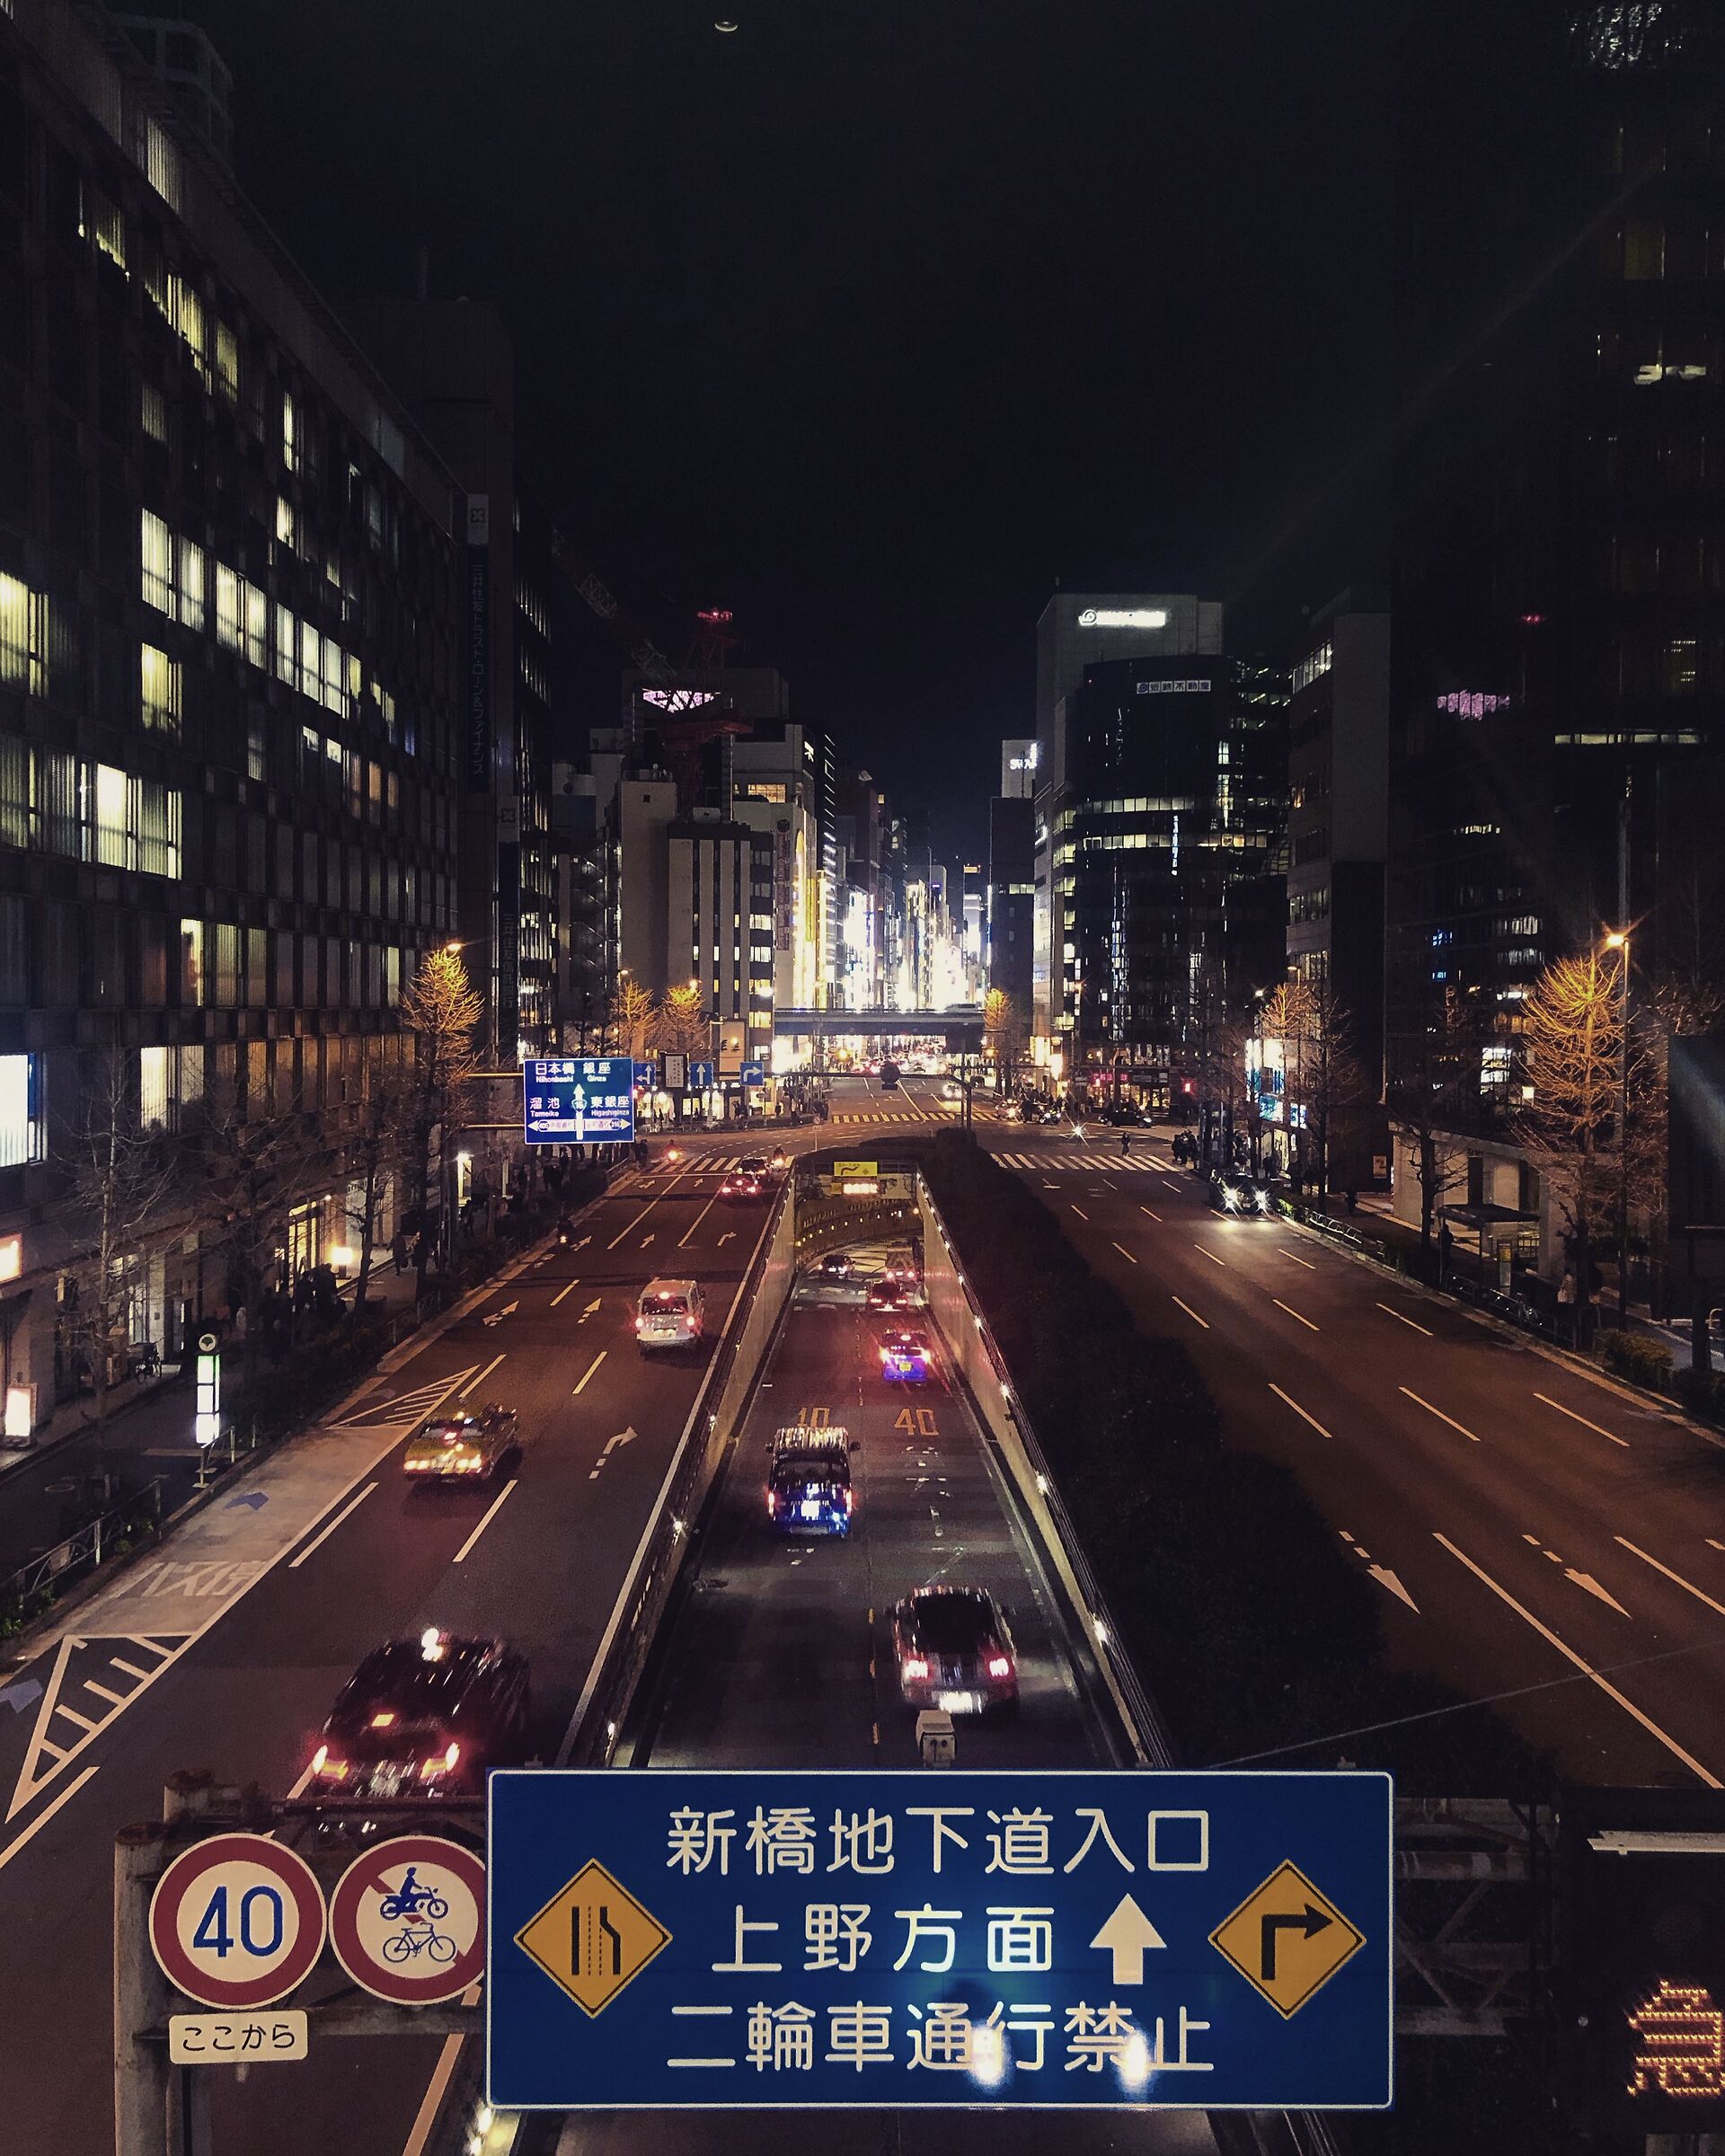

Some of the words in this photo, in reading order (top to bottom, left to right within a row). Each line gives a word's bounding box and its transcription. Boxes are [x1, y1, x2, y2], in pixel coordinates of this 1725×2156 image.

[535, 1062, 575, 1075] 日本橋
[535, 1075, 574, 1083] Nihonbashi
[582, 1062, 611, 1074] 銀座
[529, 1097, 560, 1109] 溜池
[590, 1095, 630, 1109] 東銀座
[894, 1408, 940, 1436] 40
[666, 1805, 1209, 1876] 新橋地下道入口
[192, 1885, 284, 1958] 40
[711, 1903, 1055, 1973] 上野方面
[181, 2022, 296, 2052] ここから
[667, 2000, 1215, 2075] 二輪車通行禁止
